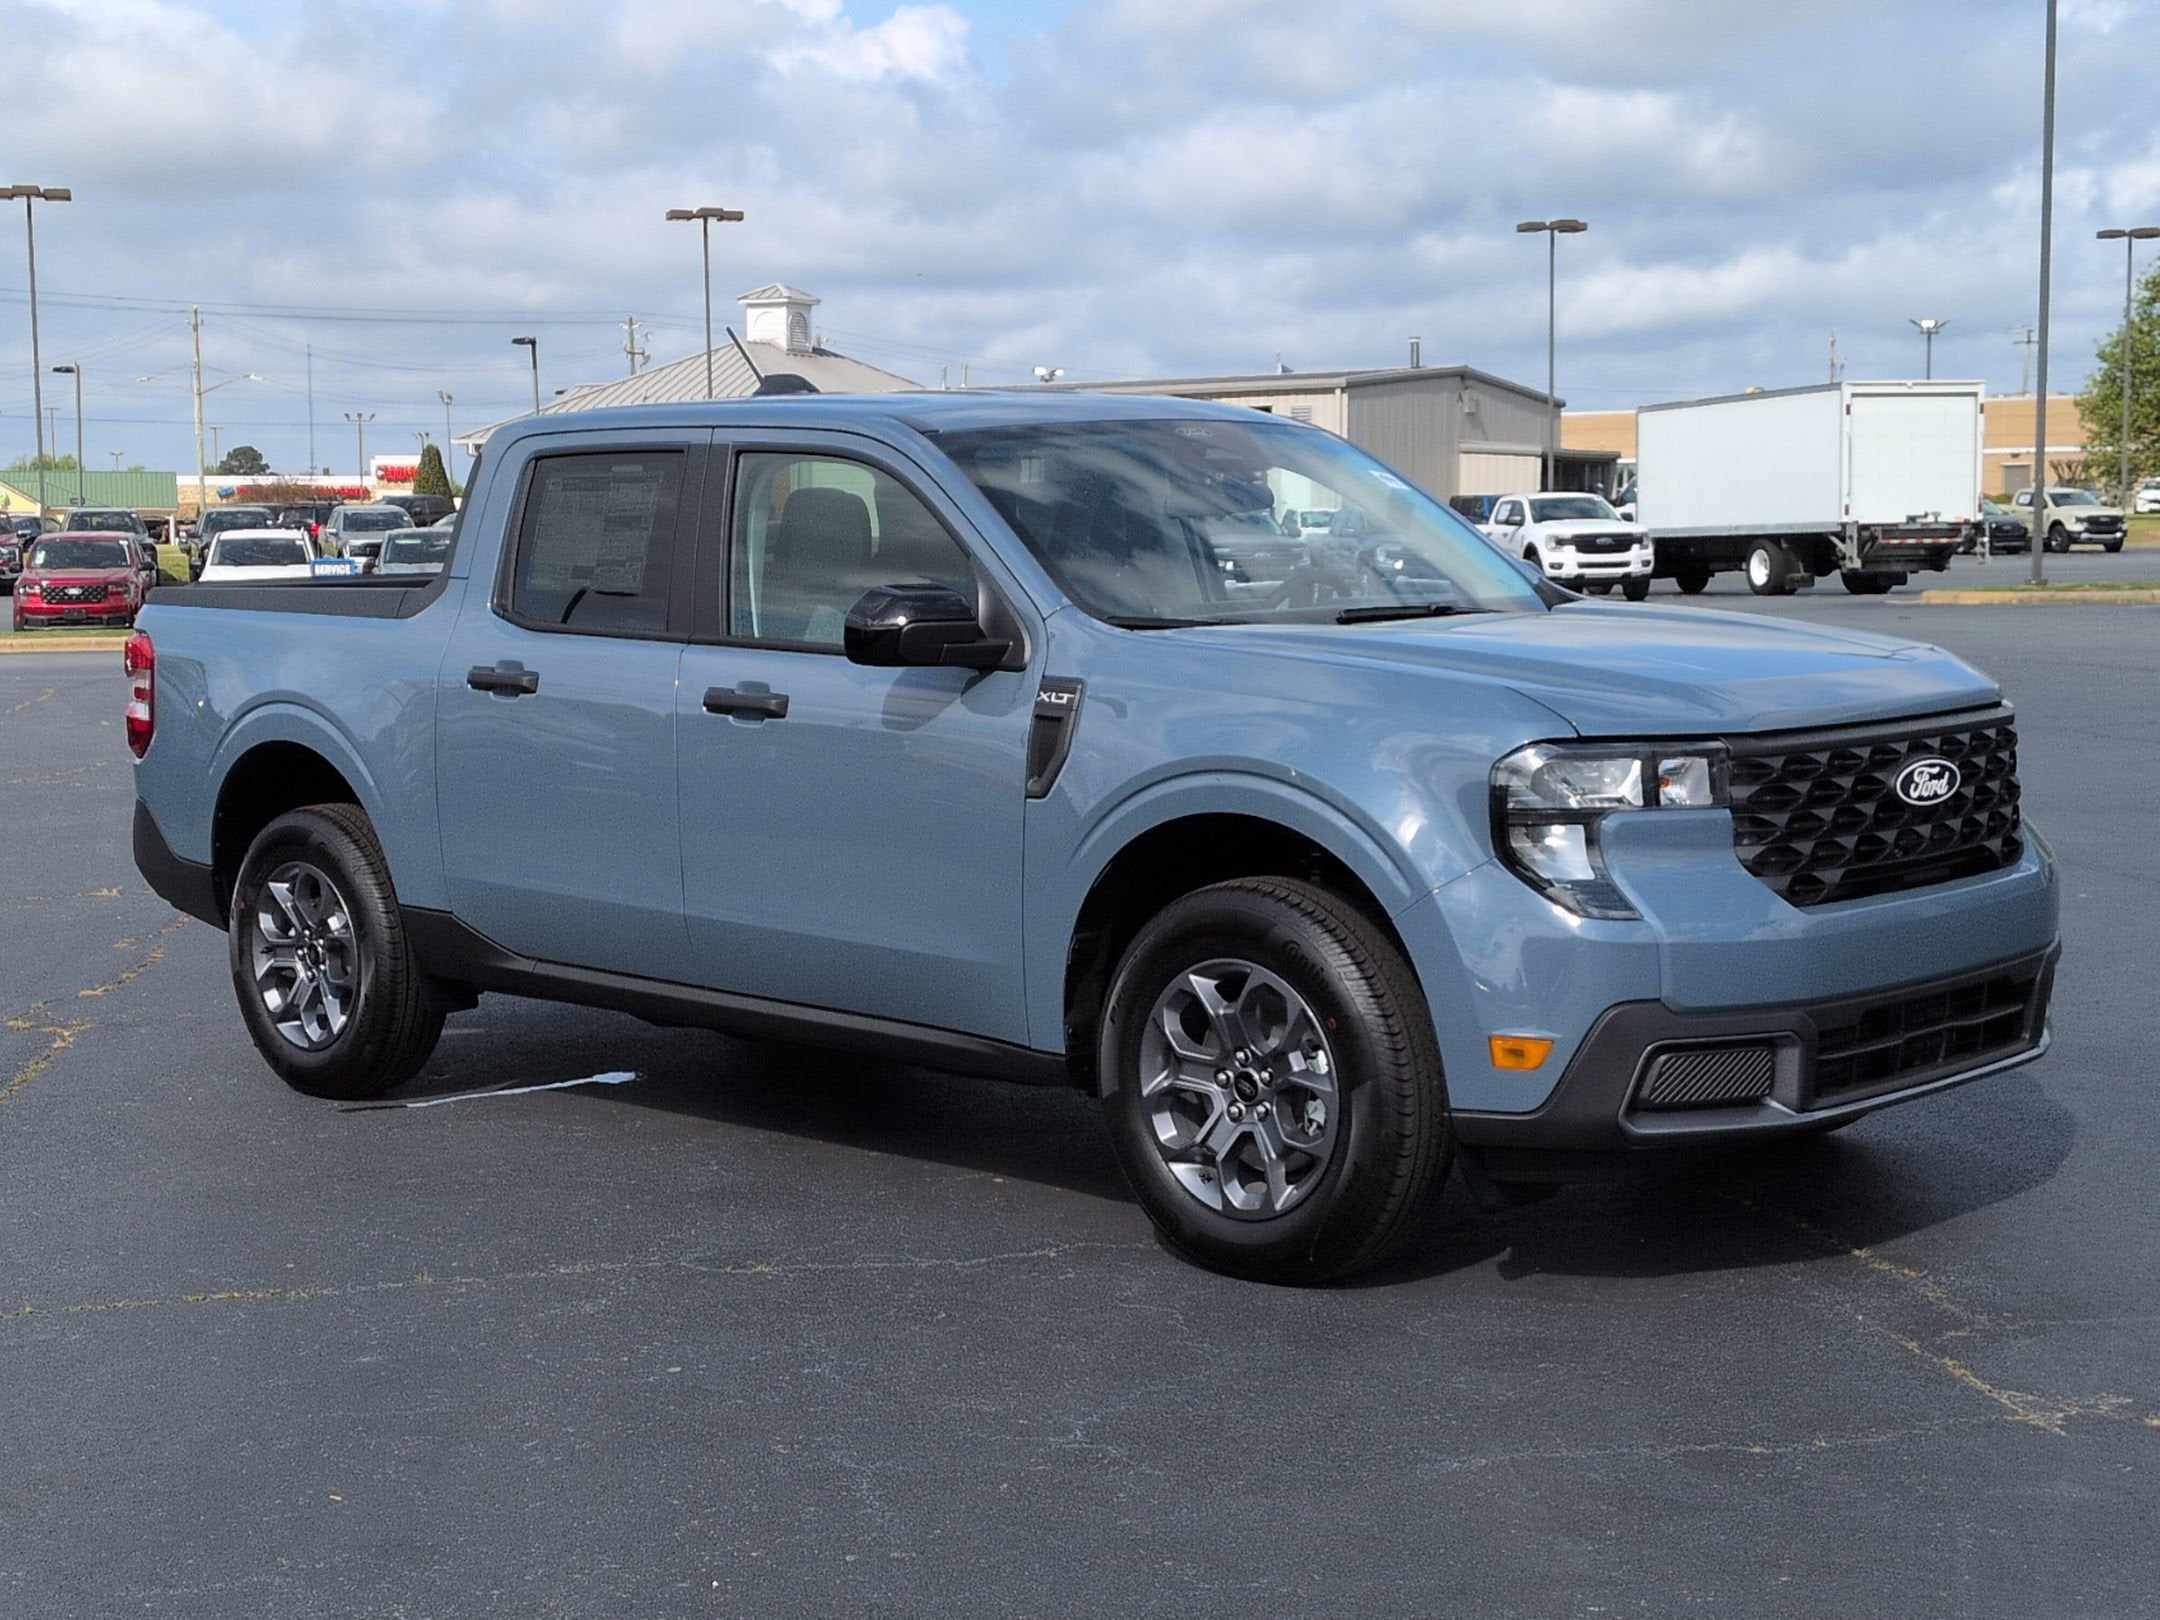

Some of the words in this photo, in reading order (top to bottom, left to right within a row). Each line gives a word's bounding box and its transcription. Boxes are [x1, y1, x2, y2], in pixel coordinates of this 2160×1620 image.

[314, 563, 351, 577] SERVICE
[1037, 691, 1075, 704] XLT
[1908, 764, 1951, 800] Ford
